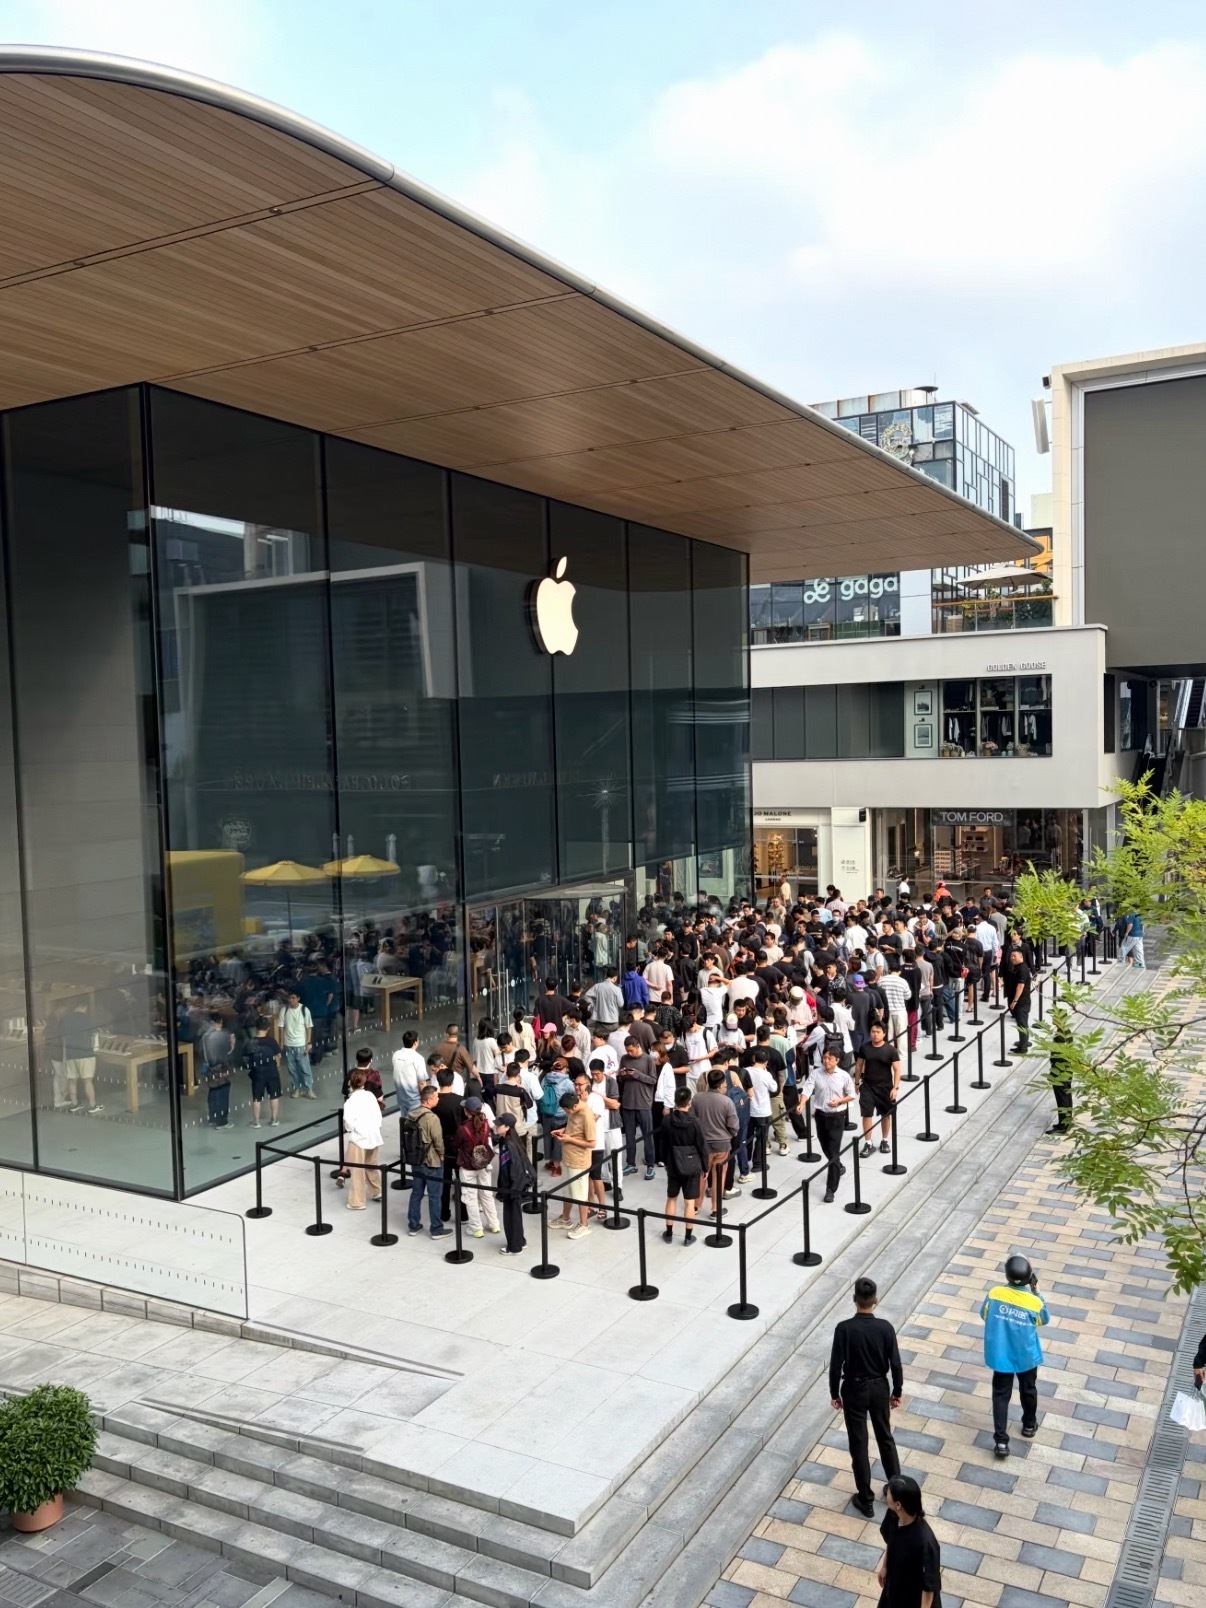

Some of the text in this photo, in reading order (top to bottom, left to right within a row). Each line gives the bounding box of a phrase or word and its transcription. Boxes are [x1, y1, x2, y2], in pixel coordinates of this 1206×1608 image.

[840, 577, 898, 600] gaga
[1019, 661, 1046, 670] GOOSE
[940, 812, 1003, 822] TOM FORD
